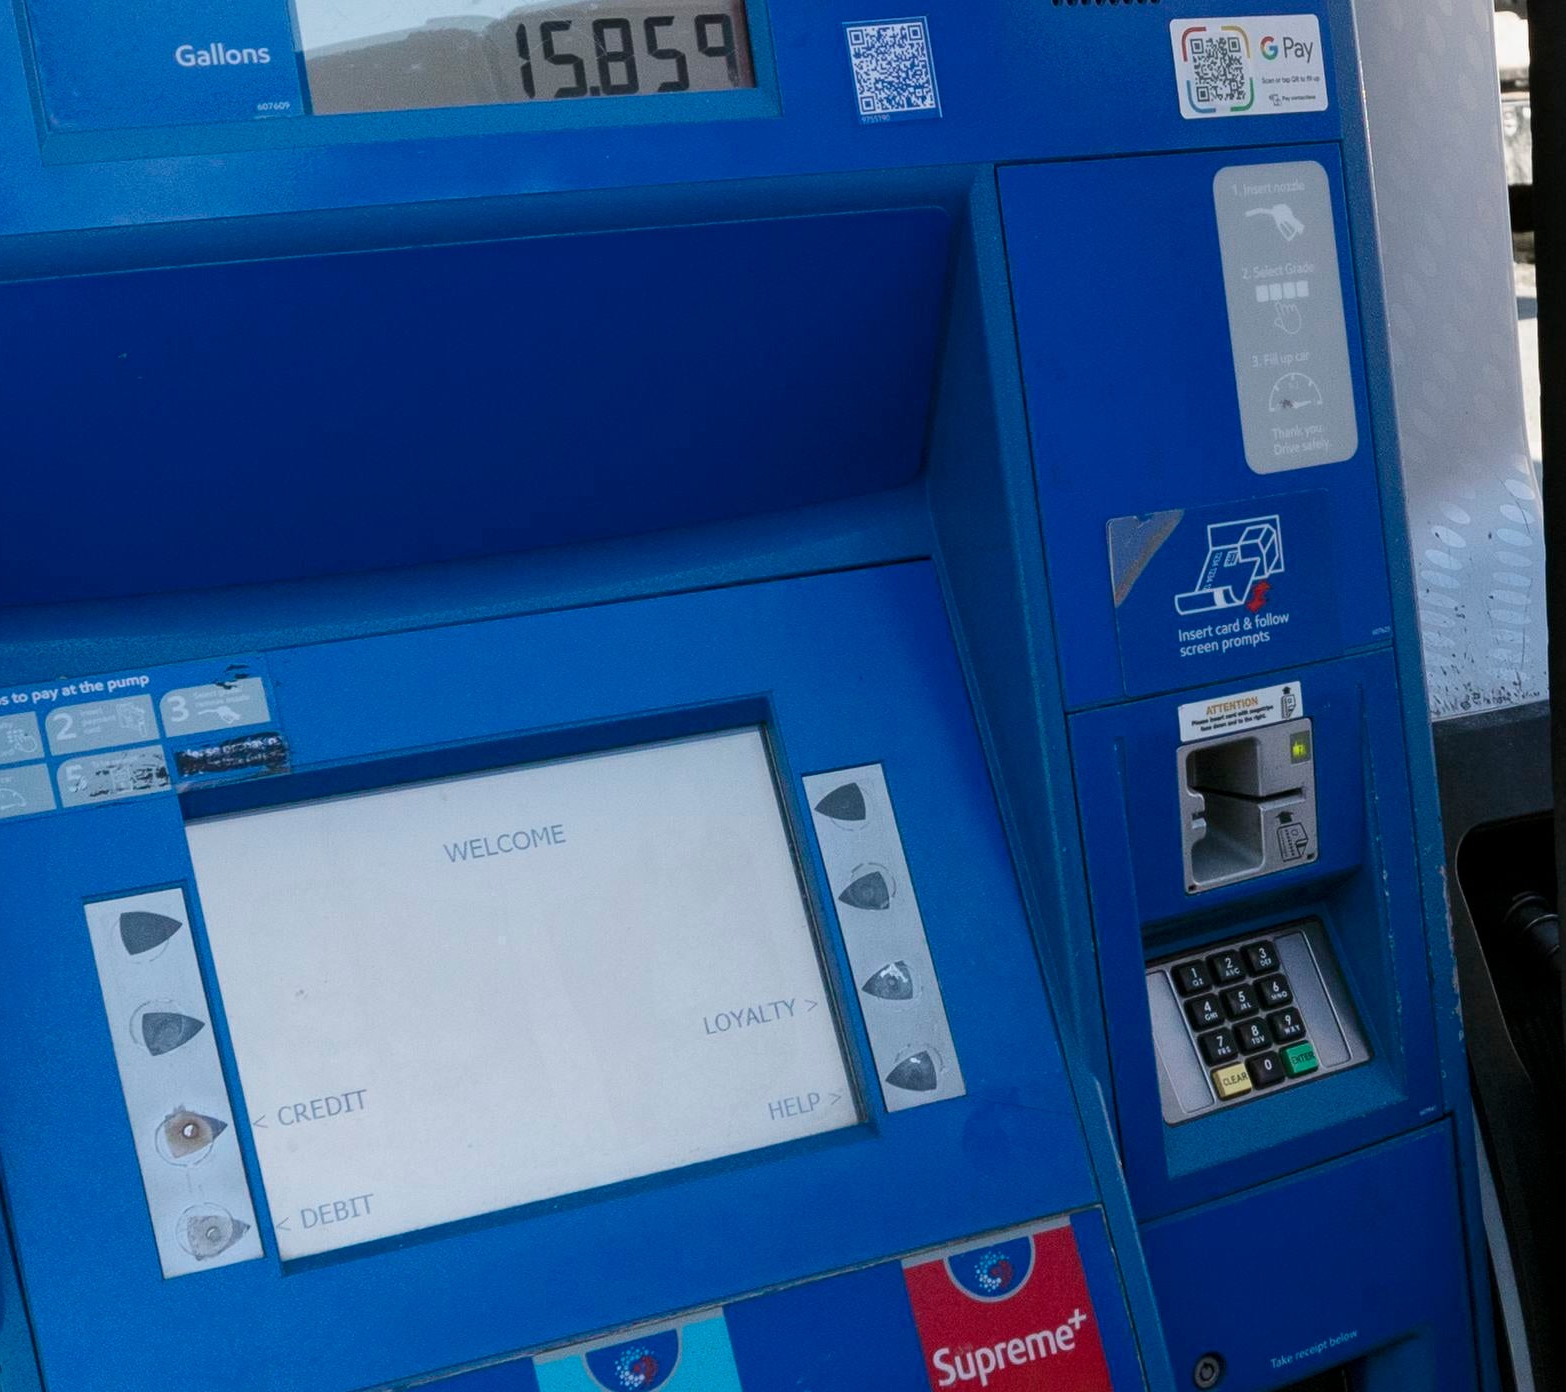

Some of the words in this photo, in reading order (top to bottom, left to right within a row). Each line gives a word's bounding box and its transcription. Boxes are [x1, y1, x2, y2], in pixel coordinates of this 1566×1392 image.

[175, 42, 270, 68] Gallons
[1260, 36, 1279, 61] G
[1283, 37, 1314, 63] Pay
[1179, 625, 1212, 642] Insert
[1215, 618, 1240, 636] card
[1243, 617, 1252, 630] &
[1255, 613, 1289, 629] follow
[1180, 641, 1219, 657] screen
[1222, 630, 1270, 653] prompts
[12, 691, 28, 704] to
[32, 687, 57, 704] pay
[62, 684, 75, 697] at
[79, 680, 104, 694] the
[107, 675, 150, 692] pump
[1206, 696, 1258, 715] ATTENTION
[444, 824, 567, 865] WELCOME
[703, 998, 796, 1037] LOYALTY
[1291, 1051, 1315, 1065] ENTER
[1223, 1071, 1249, 1087] CLEAR
[278, 1089, 368, 1127] CREDIT
[768, 1091, 822, 1123] HELP
[300, 1195, 375, 1231] DEBIT
[1270, 1355, 1293, 1369] Take
[1295, 1340, 1328, 1359] receipt
[1329, 1329, 1358, 1346] below
